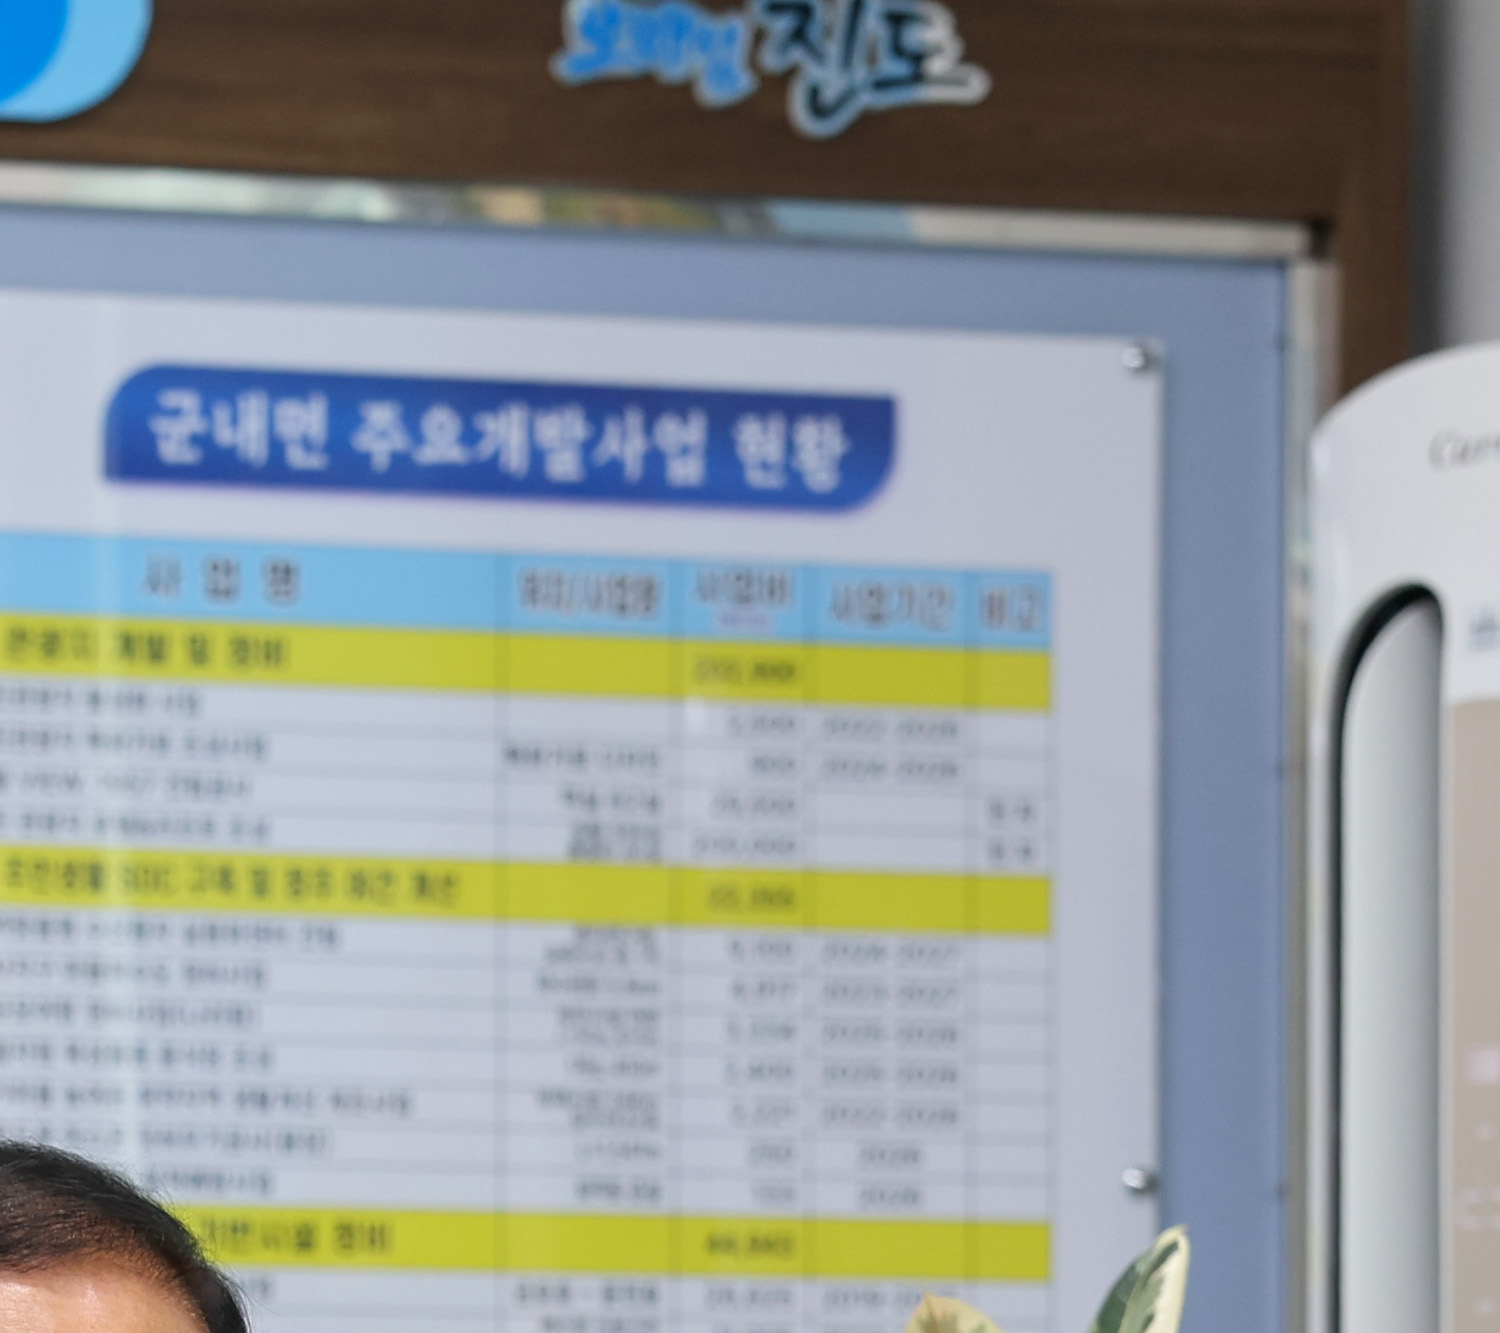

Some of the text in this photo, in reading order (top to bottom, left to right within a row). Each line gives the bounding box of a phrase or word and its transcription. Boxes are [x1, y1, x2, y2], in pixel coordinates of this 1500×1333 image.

[147, 389, 851, 496] 군내면 주요개발사업 현황
